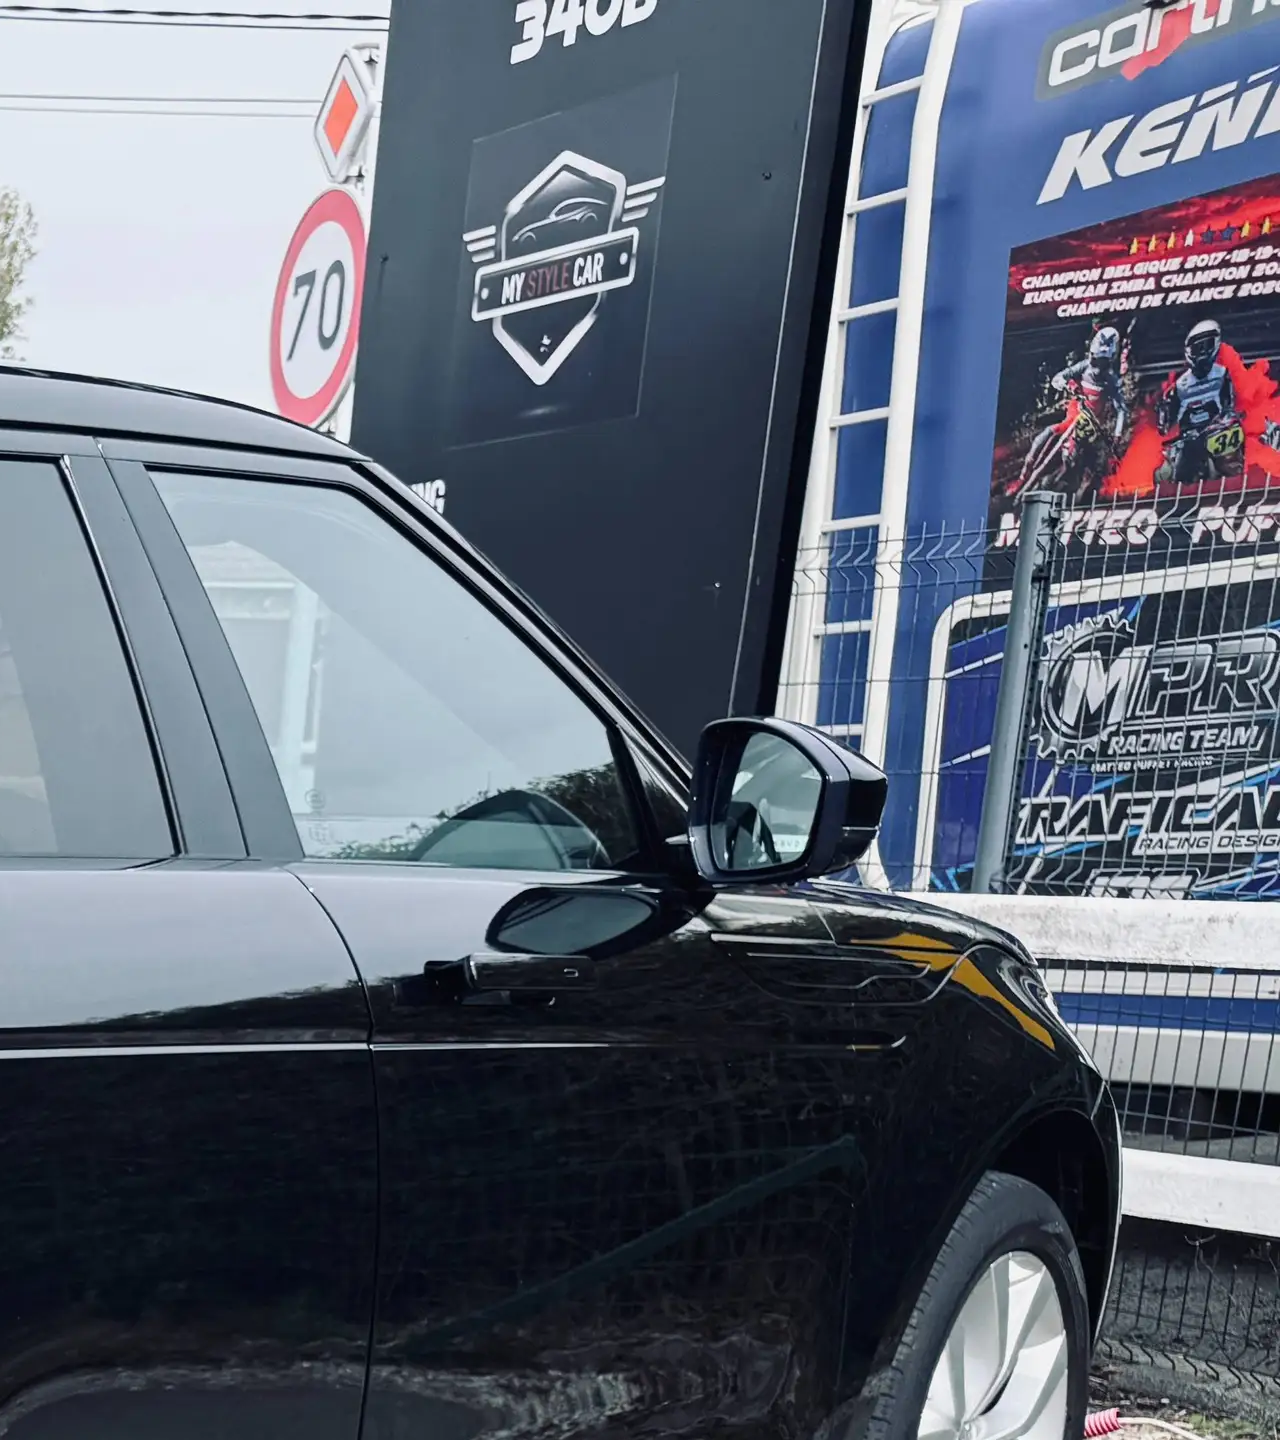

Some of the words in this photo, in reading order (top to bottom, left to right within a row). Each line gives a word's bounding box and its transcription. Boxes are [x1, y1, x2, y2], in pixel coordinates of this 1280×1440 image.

[501, 273, 526, 305] MY
[526, 261, 570, 298] STYLE
[572, 252, 604, 288] CAR
[1021, 268, 1102, 290] CHAMPION
[1102, 256, 1183, 281] BELGIQUE
[1184, 245, 1280, 269] 2017-18-19-
[1023, 284, 1109, 306] EUROPEAN
[1110, 277, 1156, 295] IMBA
[1160, 264, 1251, 289] CHAMPION
[1251, 261, 1280, 278] 20
[287, 259, 345, 362] 70
[1056, 298, 1139, 319] CHAMPION
[1140, 294, 1164, 310] DE
[1166, 284, 1237, 306] FRANCE
[1214, 426, 1241, 454] 34
[994, 508, 1159, 547] MTTEO
[1191, 505, 1280, 544] PUF
[1108, 731, 1184, 755] RACING
[1191, 725, 1259, 750] TEAM
[1139, 835, 1210, 850] RACING
[1216, 833, 1280, 849] DESIG
